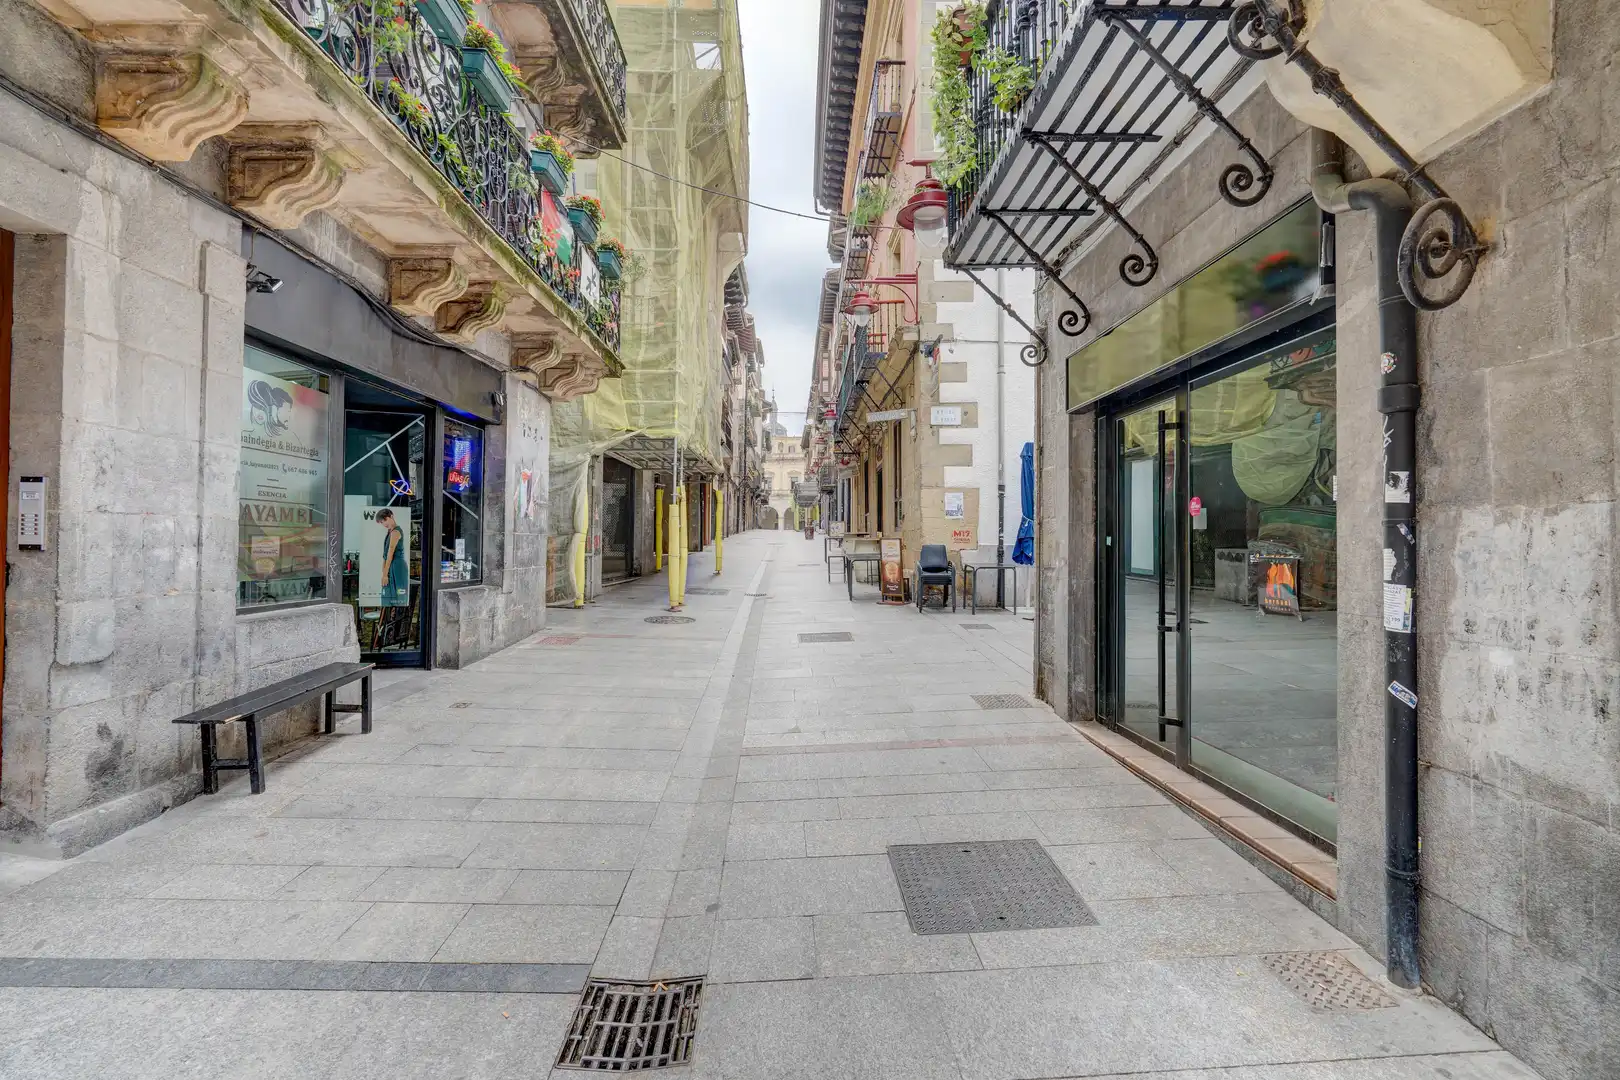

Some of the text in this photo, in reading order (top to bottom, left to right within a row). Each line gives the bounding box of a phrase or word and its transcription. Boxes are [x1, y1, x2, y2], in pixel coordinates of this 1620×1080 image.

[279, 441, 284, 451] &
[285, 442, 319, 457] Bizartegia
[257, 490, 287, 499] ESENCIA
